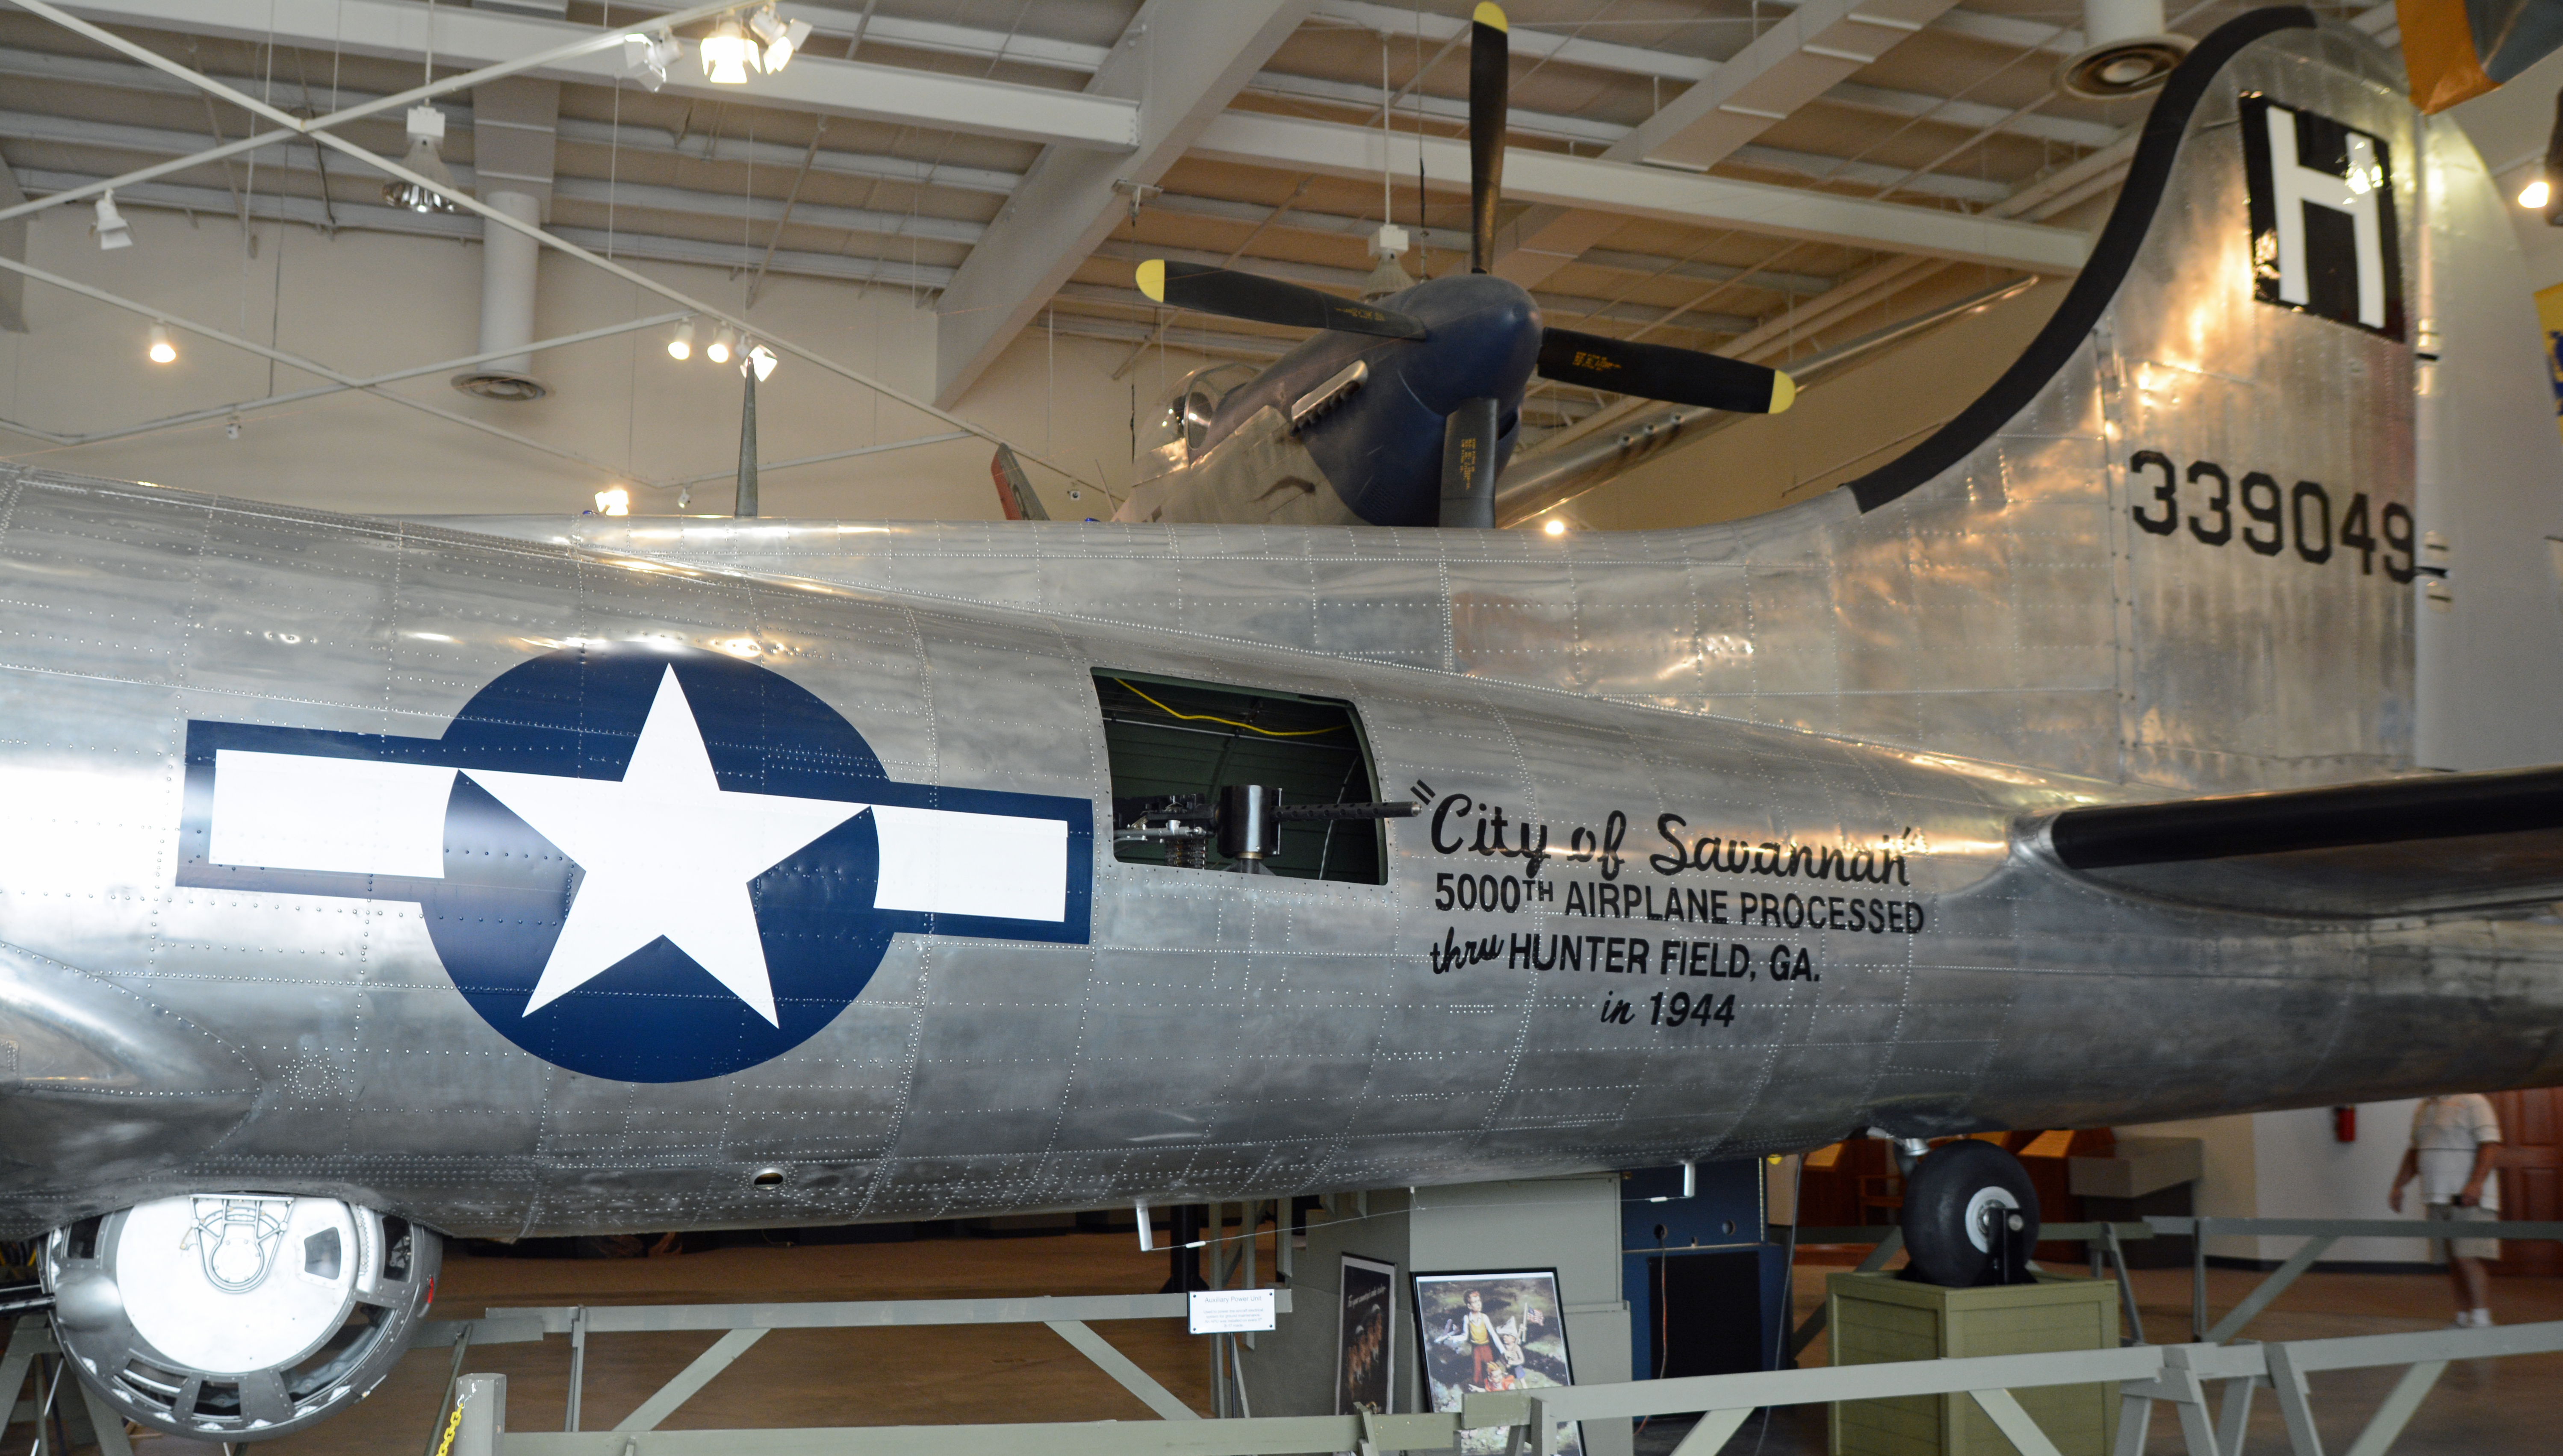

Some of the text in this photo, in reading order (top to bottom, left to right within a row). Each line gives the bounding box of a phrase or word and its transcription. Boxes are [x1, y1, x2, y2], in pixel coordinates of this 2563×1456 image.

[2266, 105, 2386, 328] H
[2130, 449, 2416, 585] 339049
[1566, 810, 1626, 881] of
[1435, 872, 1924, 934] 5000TH AIRPLANE PROCESSED
[1430, 926, 1820, 982] thru HUNTER FIELD, GA.
[1600, 990, 1735, 1027] in 1944
